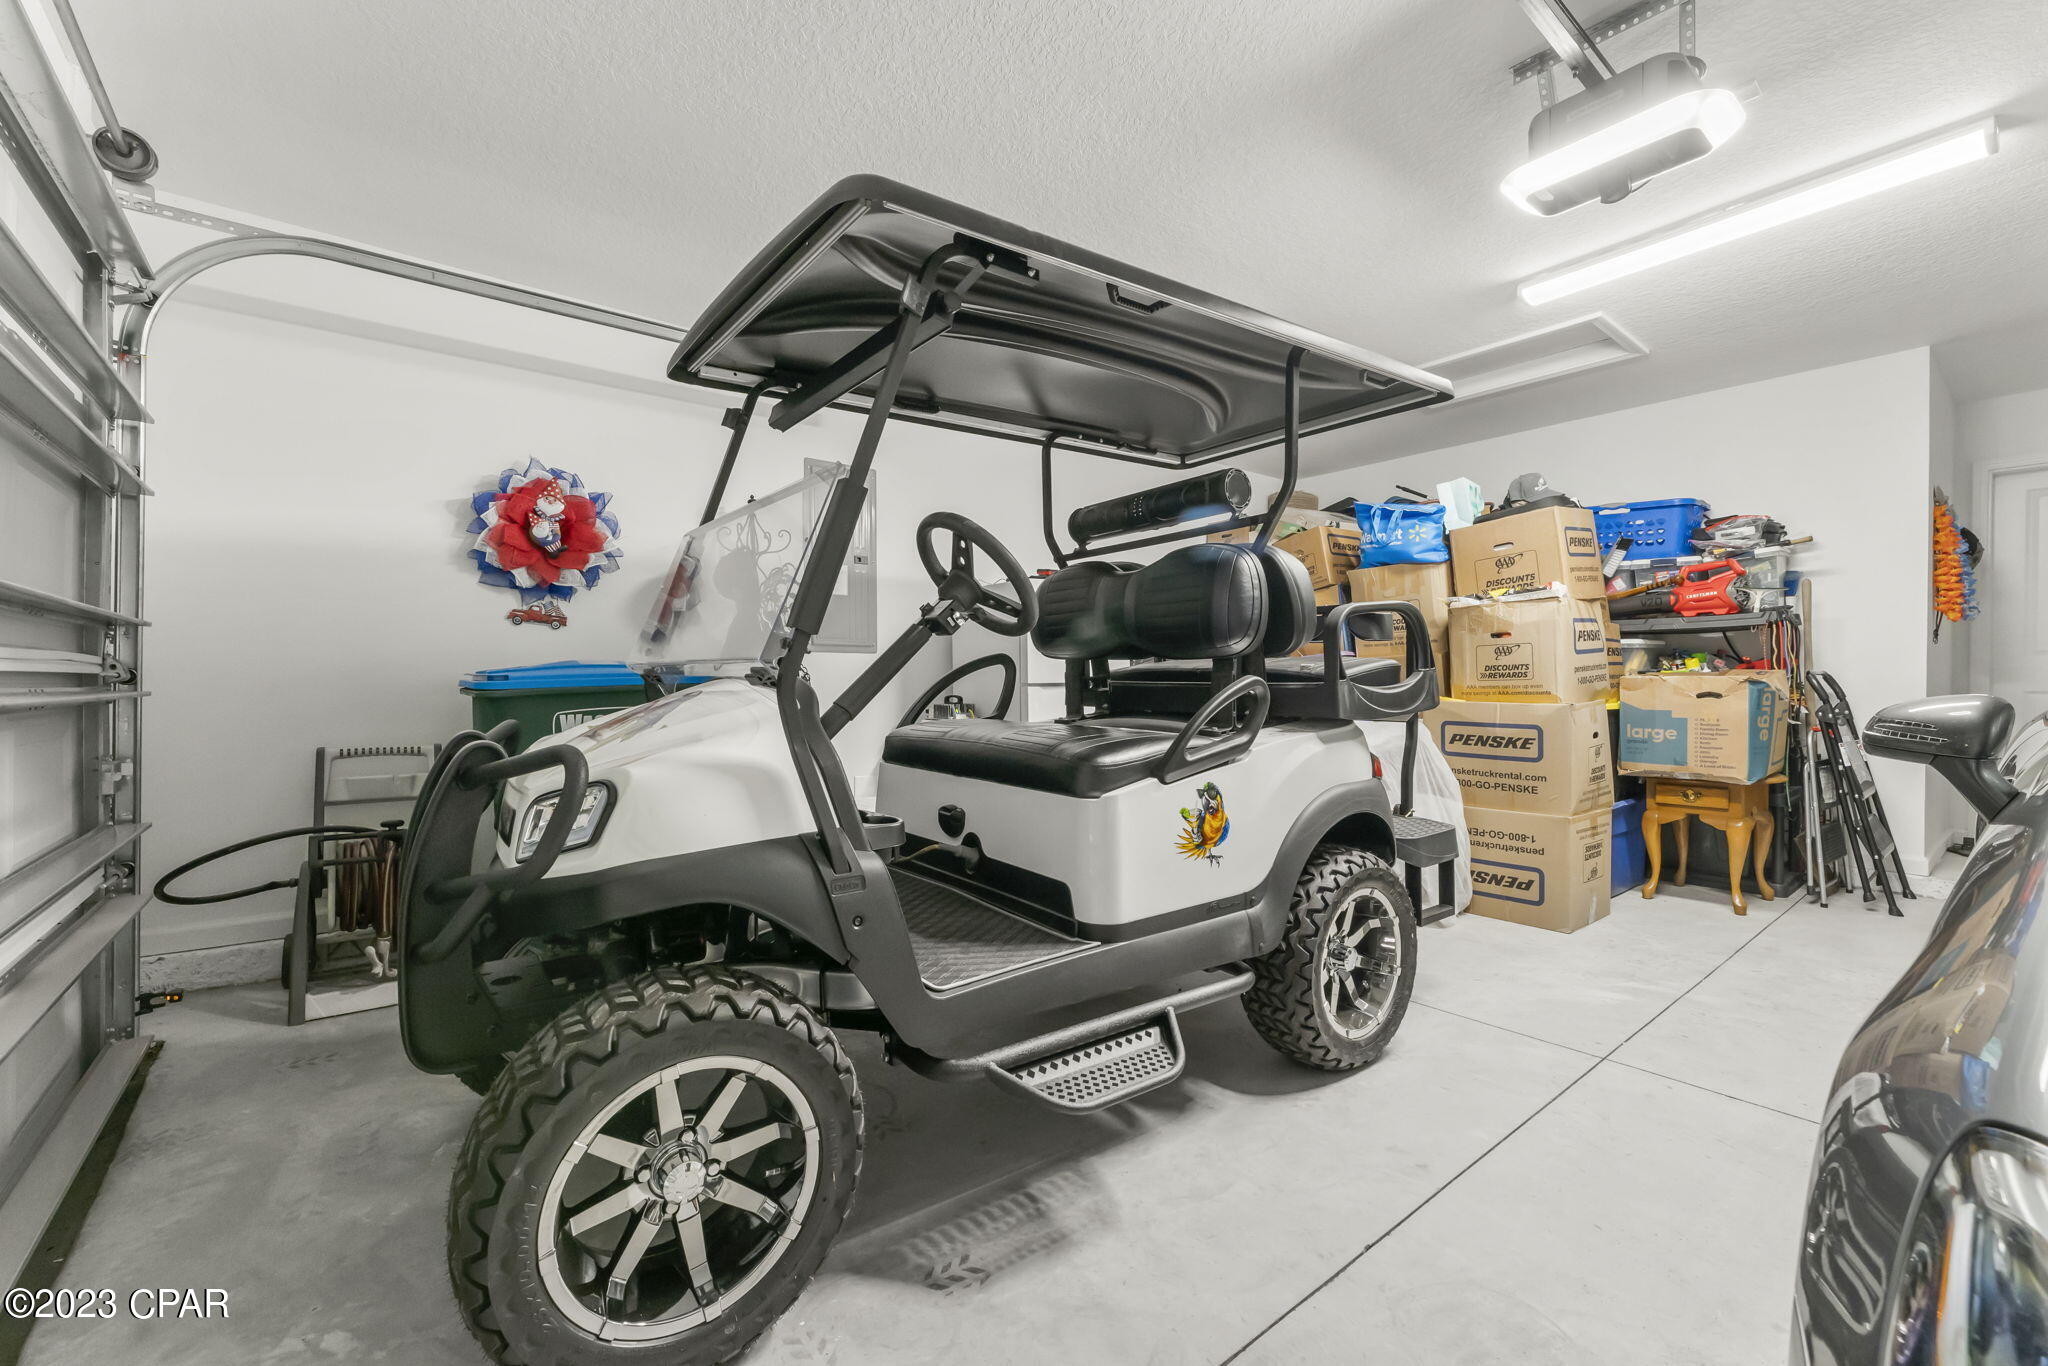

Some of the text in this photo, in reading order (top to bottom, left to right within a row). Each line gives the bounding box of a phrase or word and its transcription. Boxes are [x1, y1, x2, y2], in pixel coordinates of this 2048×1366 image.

[1569, 537, 1593, 547] PENSKE
[1486, 573, 1535, 588] DISCOUNTS
[1577, 630, 1601, 641] PENSKE
[1484, 664, 1530, 672] DISCOUNTS
[1488, 671, 1528, 679] REWARDS
[1757, 687, 1775, 741] large
[1626, 723, 1678, 743] large
[1449, 733, 1537, 750] PENSKE
[1451, 767, 1547, 782] nsketruckrental.com
[1467, 827, 1536, 843] 1-800-GO-PEN
[1470, 839, 1545, 855] pensketruckren
[1471, 870, 1535, 891] PENS
